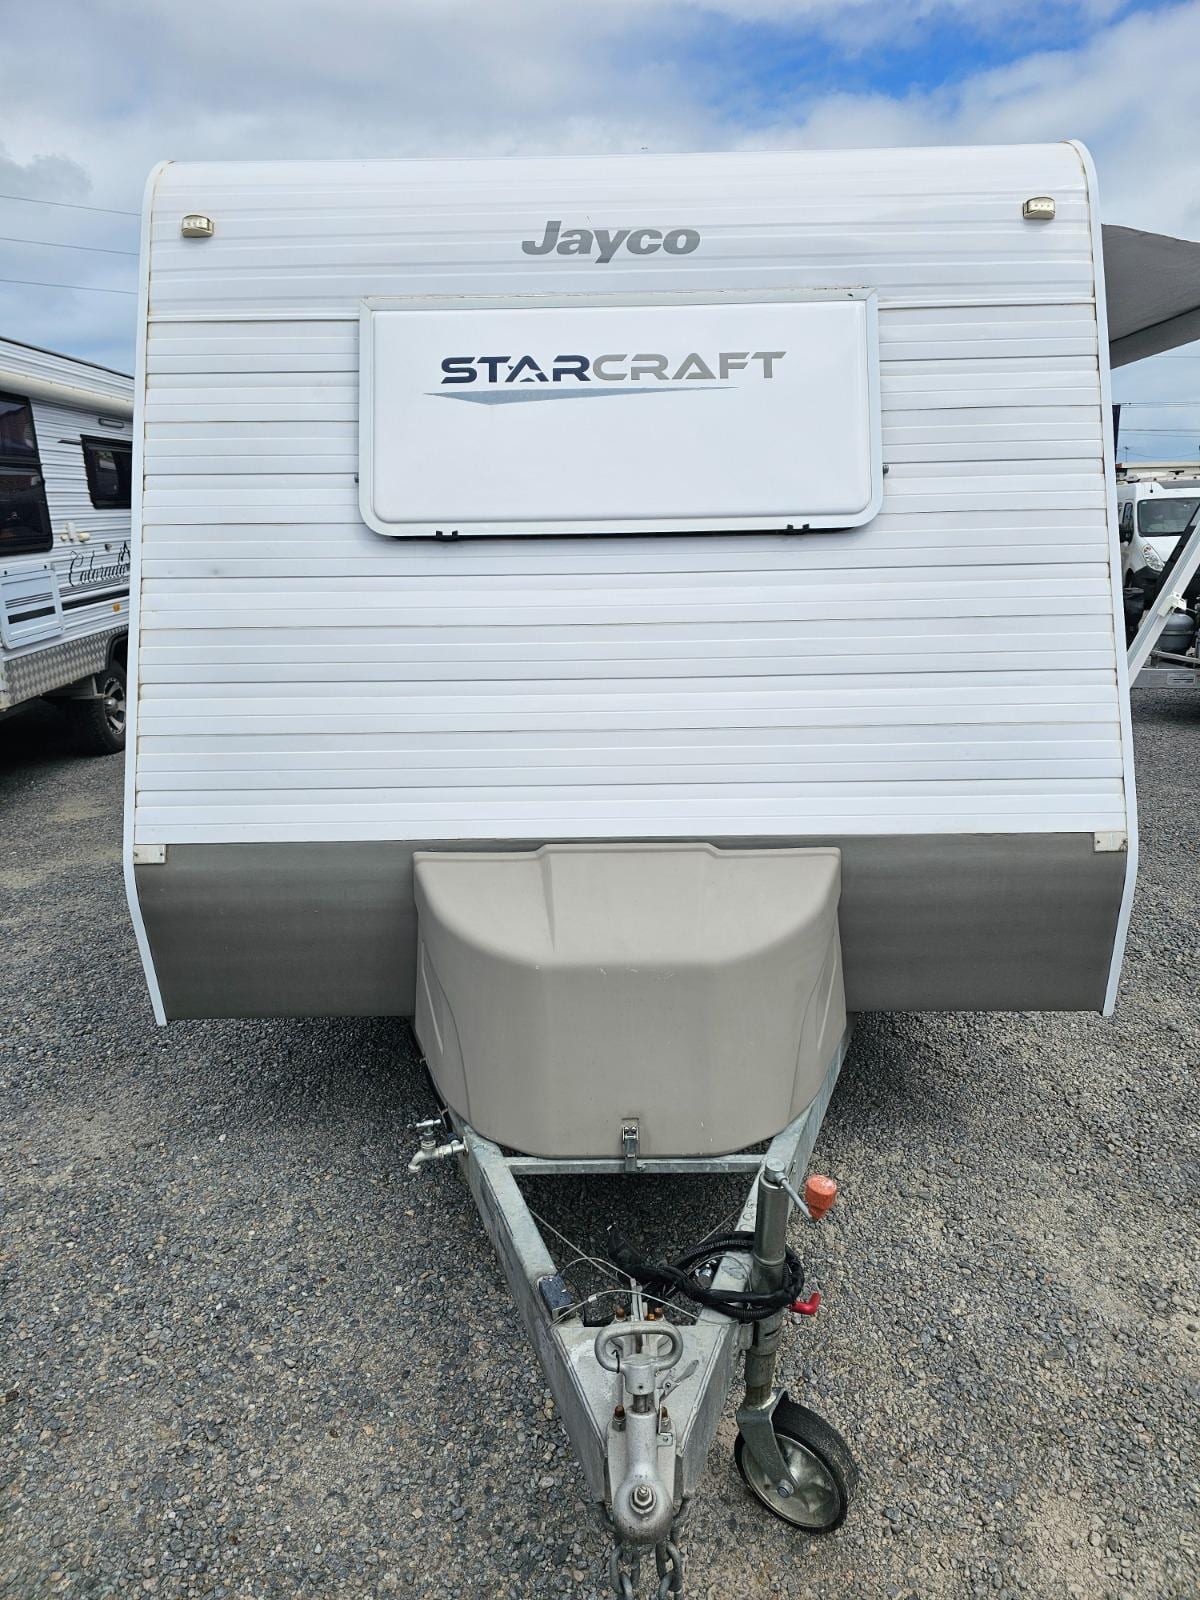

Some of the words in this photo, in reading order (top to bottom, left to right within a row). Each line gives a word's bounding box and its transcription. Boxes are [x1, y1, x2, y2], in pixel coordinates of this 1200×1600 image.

[521, 220, 701, 263] Jayco
[441, 351, 787, 384] STARCRAFT
[69, 548, 127, 587] Colorado
